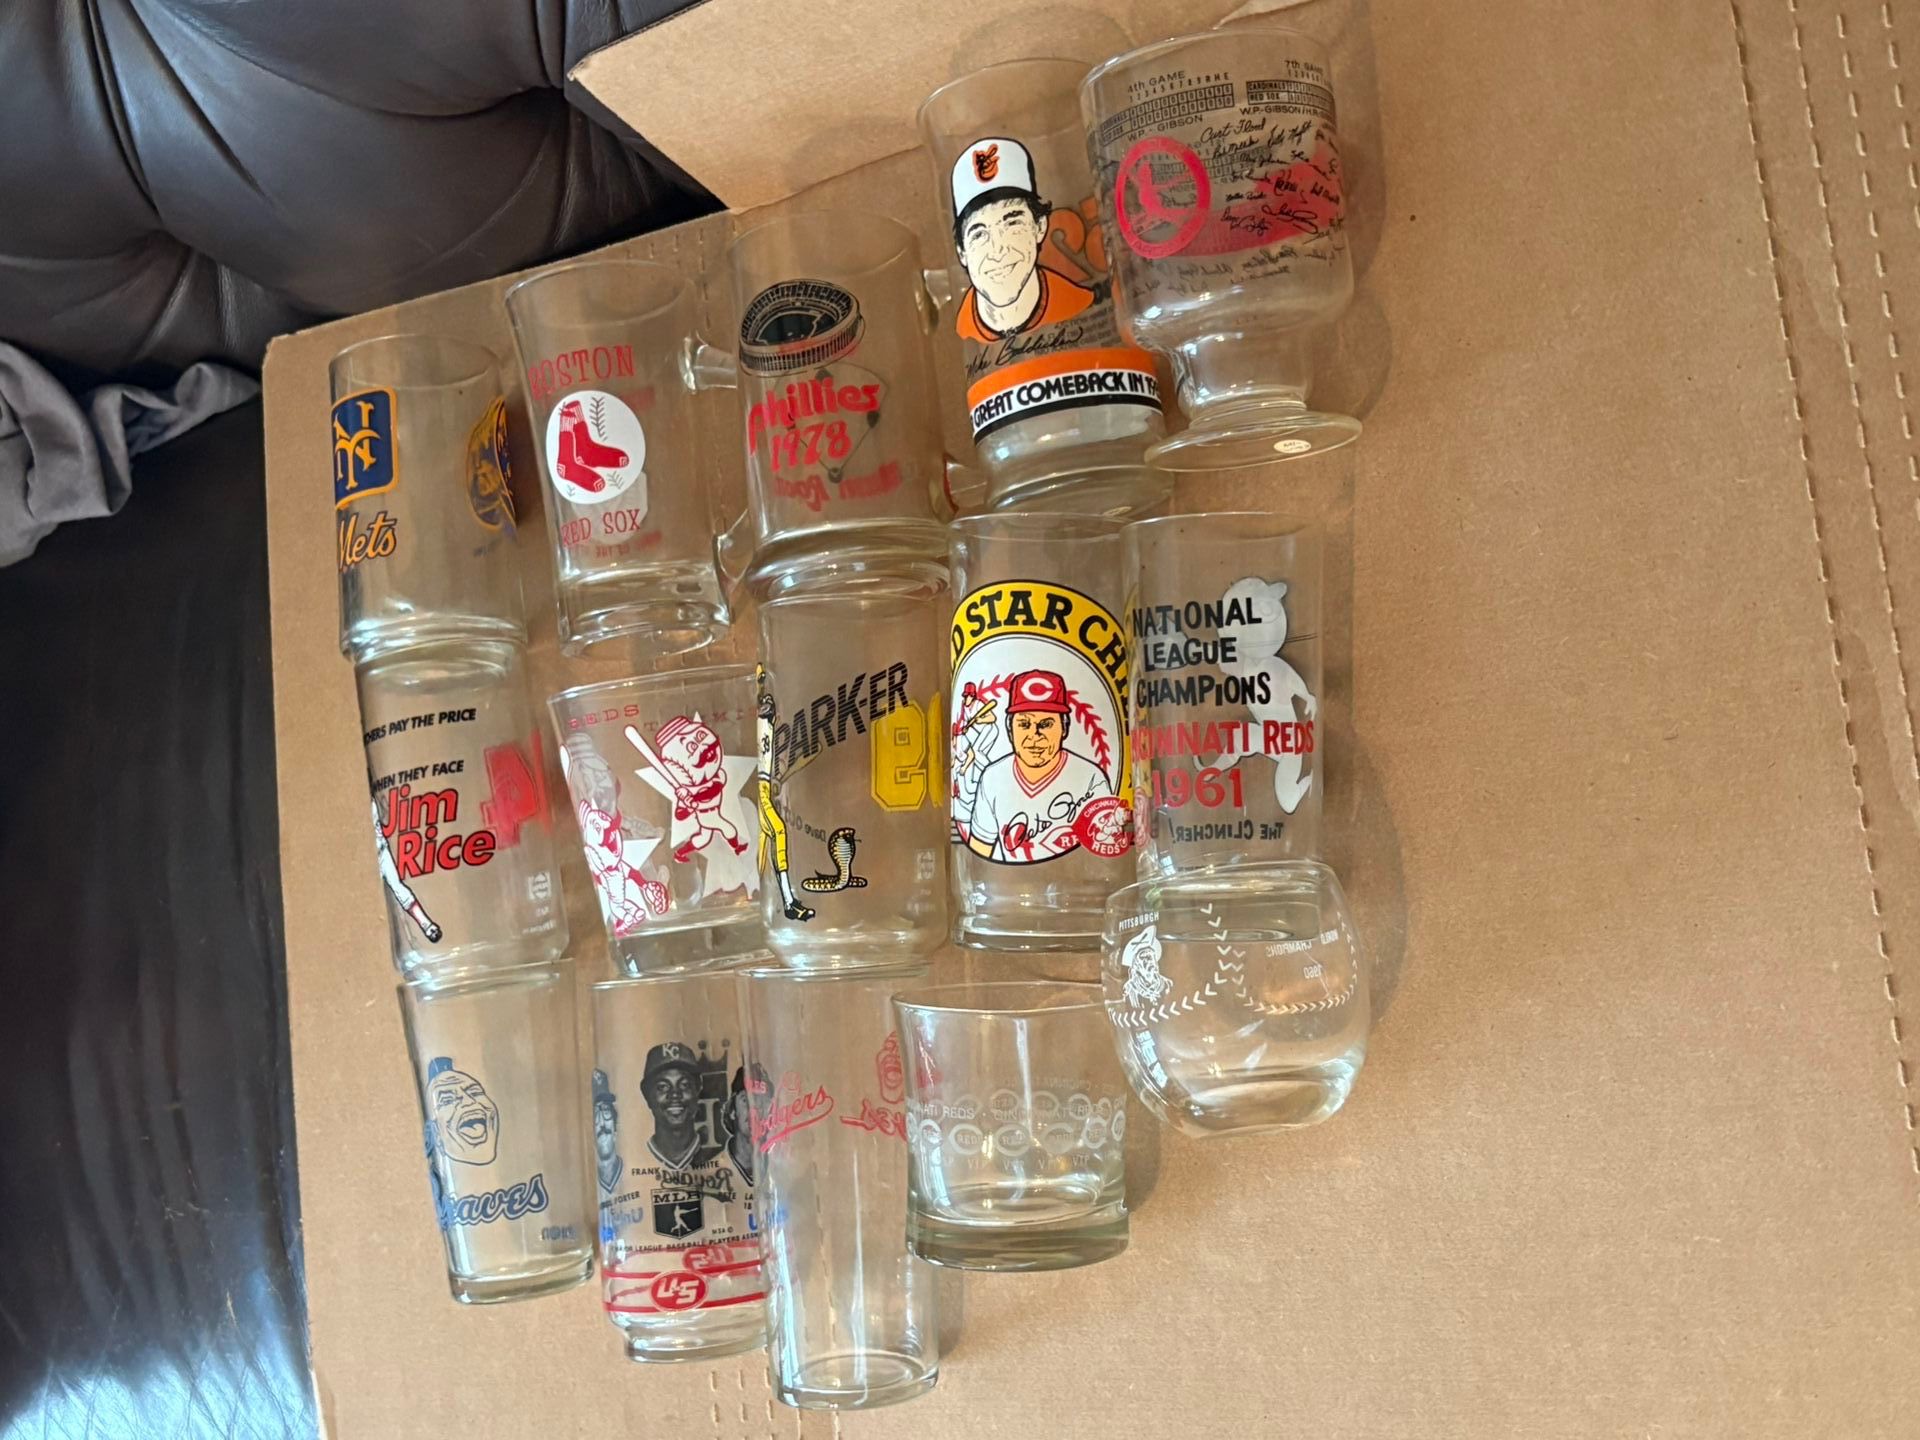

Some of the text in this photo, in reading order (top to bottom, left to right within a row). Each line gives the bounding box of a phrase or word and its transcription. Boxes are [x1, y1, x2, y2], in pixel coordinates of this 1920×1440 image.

[1149, 70, 1185, 86] GAME
[1156, 114, 1203, 133] GIBSON
[528, 345, 635, 401] BOSTON
[973, 391, 1014, 427] GREAT
[1016, 371, 1125, 404] COMEBACK
[1128, 372, 1144, 392] IN
[771, 420, 852, 473] 1978
[560, 508, 641, 548] RED SOX
[966, 591, 1073, 638] STAR
[1132, 597, 1262, 638] NATIONAL
[1144, 637, 1237, 672] LEAGUE
[1137, 671, 1271, 709] CHAMPIONS
[388, 718, 410, 736] PAY
[411, 713, 435, 730] THE
[438, 708, 477, 725] PRICE
[1263, 720, 1315, 755] REDS
[398, 765, 429, 784] THEY
[432, 760, 464, 777] FACE
[1151, 767, 1244, 809] 1961
[382, 783, 459, 840] Jim
[397, 825, 497, 882] Rice
[1091, 840, 1122, 855] REDS
[1118, 911, 1159, 932] PITTSBURGH
[662, 1043, 680, 1059] KC
[942, 1105, 976, 1120] REDS
[632, 1159, 720, 1177] FRANK WHITE
[708, 1234, 741, 1245] PLAYERS
